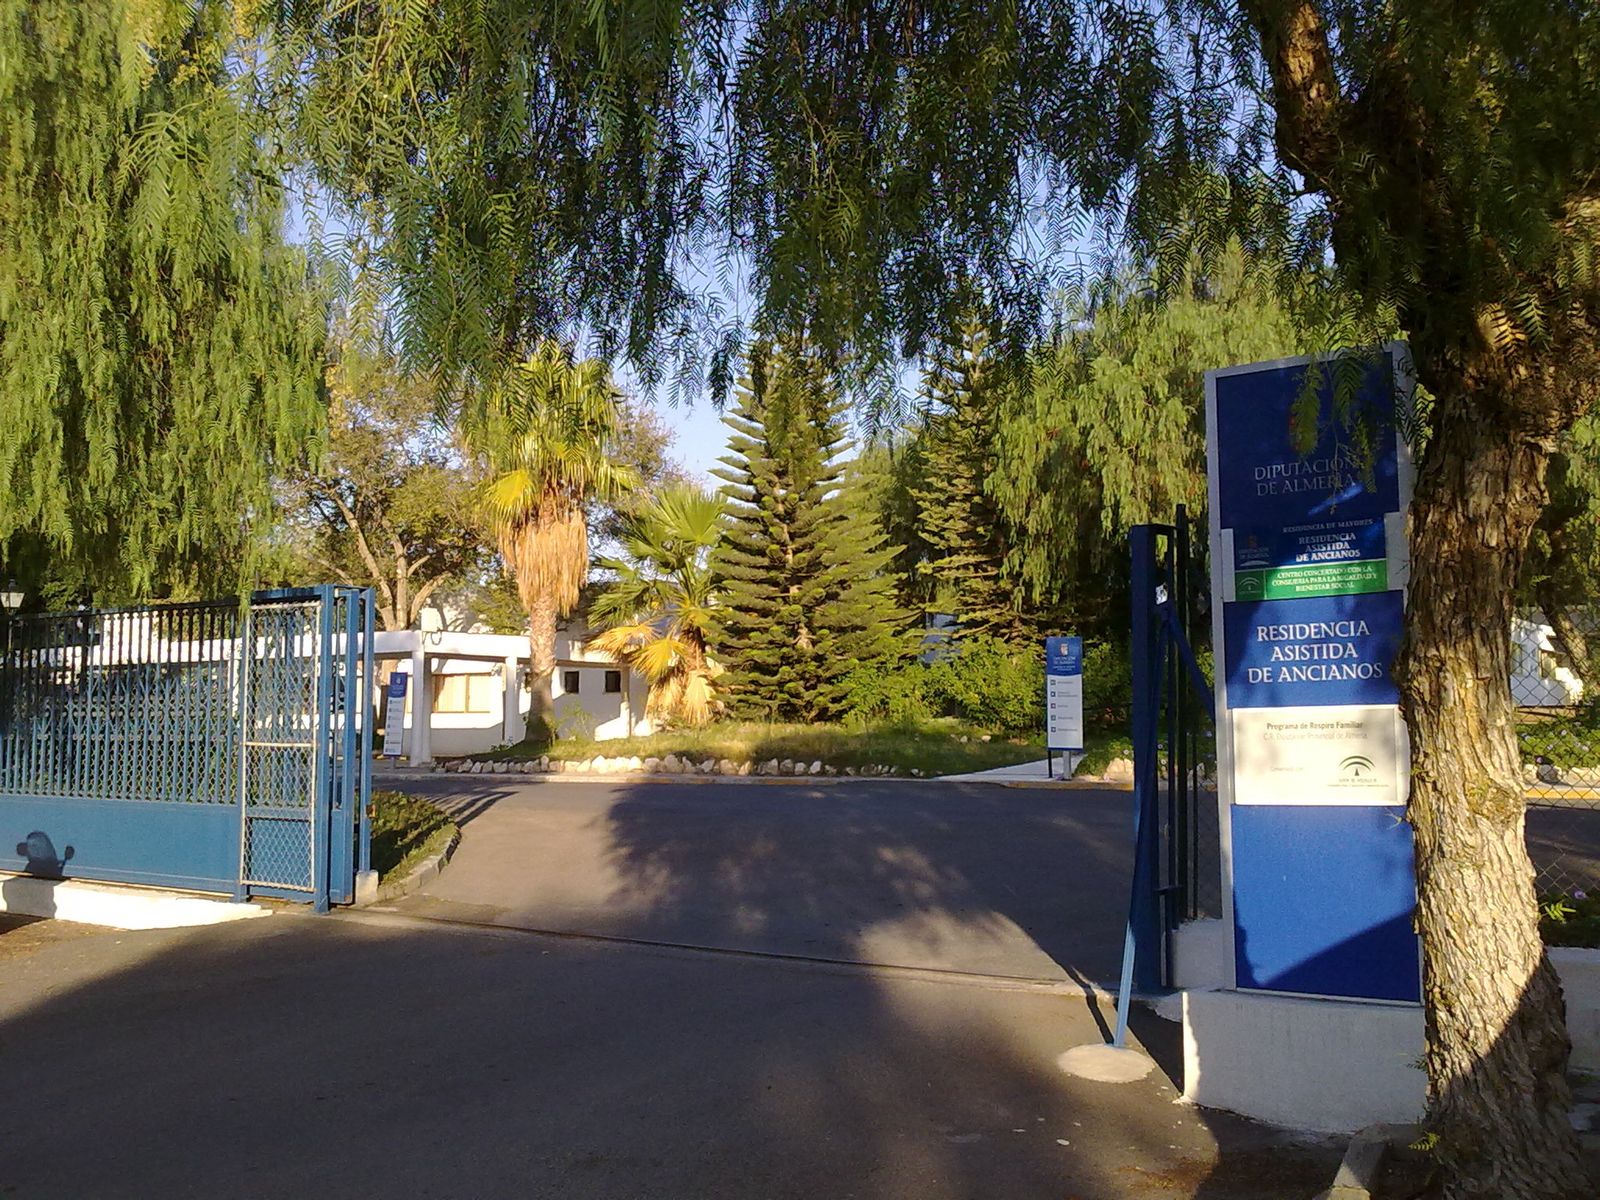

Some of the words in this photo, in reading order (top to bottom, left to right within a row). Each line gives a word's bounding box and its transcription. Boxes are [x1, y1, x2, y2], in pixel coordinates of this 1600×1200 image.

[1257, 481, 1277, 496] DE
[1338, 518, 1373, 528] MAYORES
[1298, 532, 1356, 544] RESIDENCIA
[1305, 541, 1350, 552] ASISTIDA
[1295, 553, 1309, 562] DE
[1311, 549, 1361, 561] ANCIANOS
[1277, 571, 1303, 579] CENTRO
[1310, 576, 1327, 584] PARA
[1296, 583, 1330, 592] BIENESTAR
[1257, 620, 1370, 642] RESIDENCIA
[1270, 642, 1359, 662] ASISTIDA
[1248, 667, 1273, 684] DE
[1277, 662, 1383, 683] ANCIANOS
[1266, 722, 1298, 731] Programa
[1310, 721, 1334, 730] Respiro
[1336, 721, 1363, 729] Familiar
